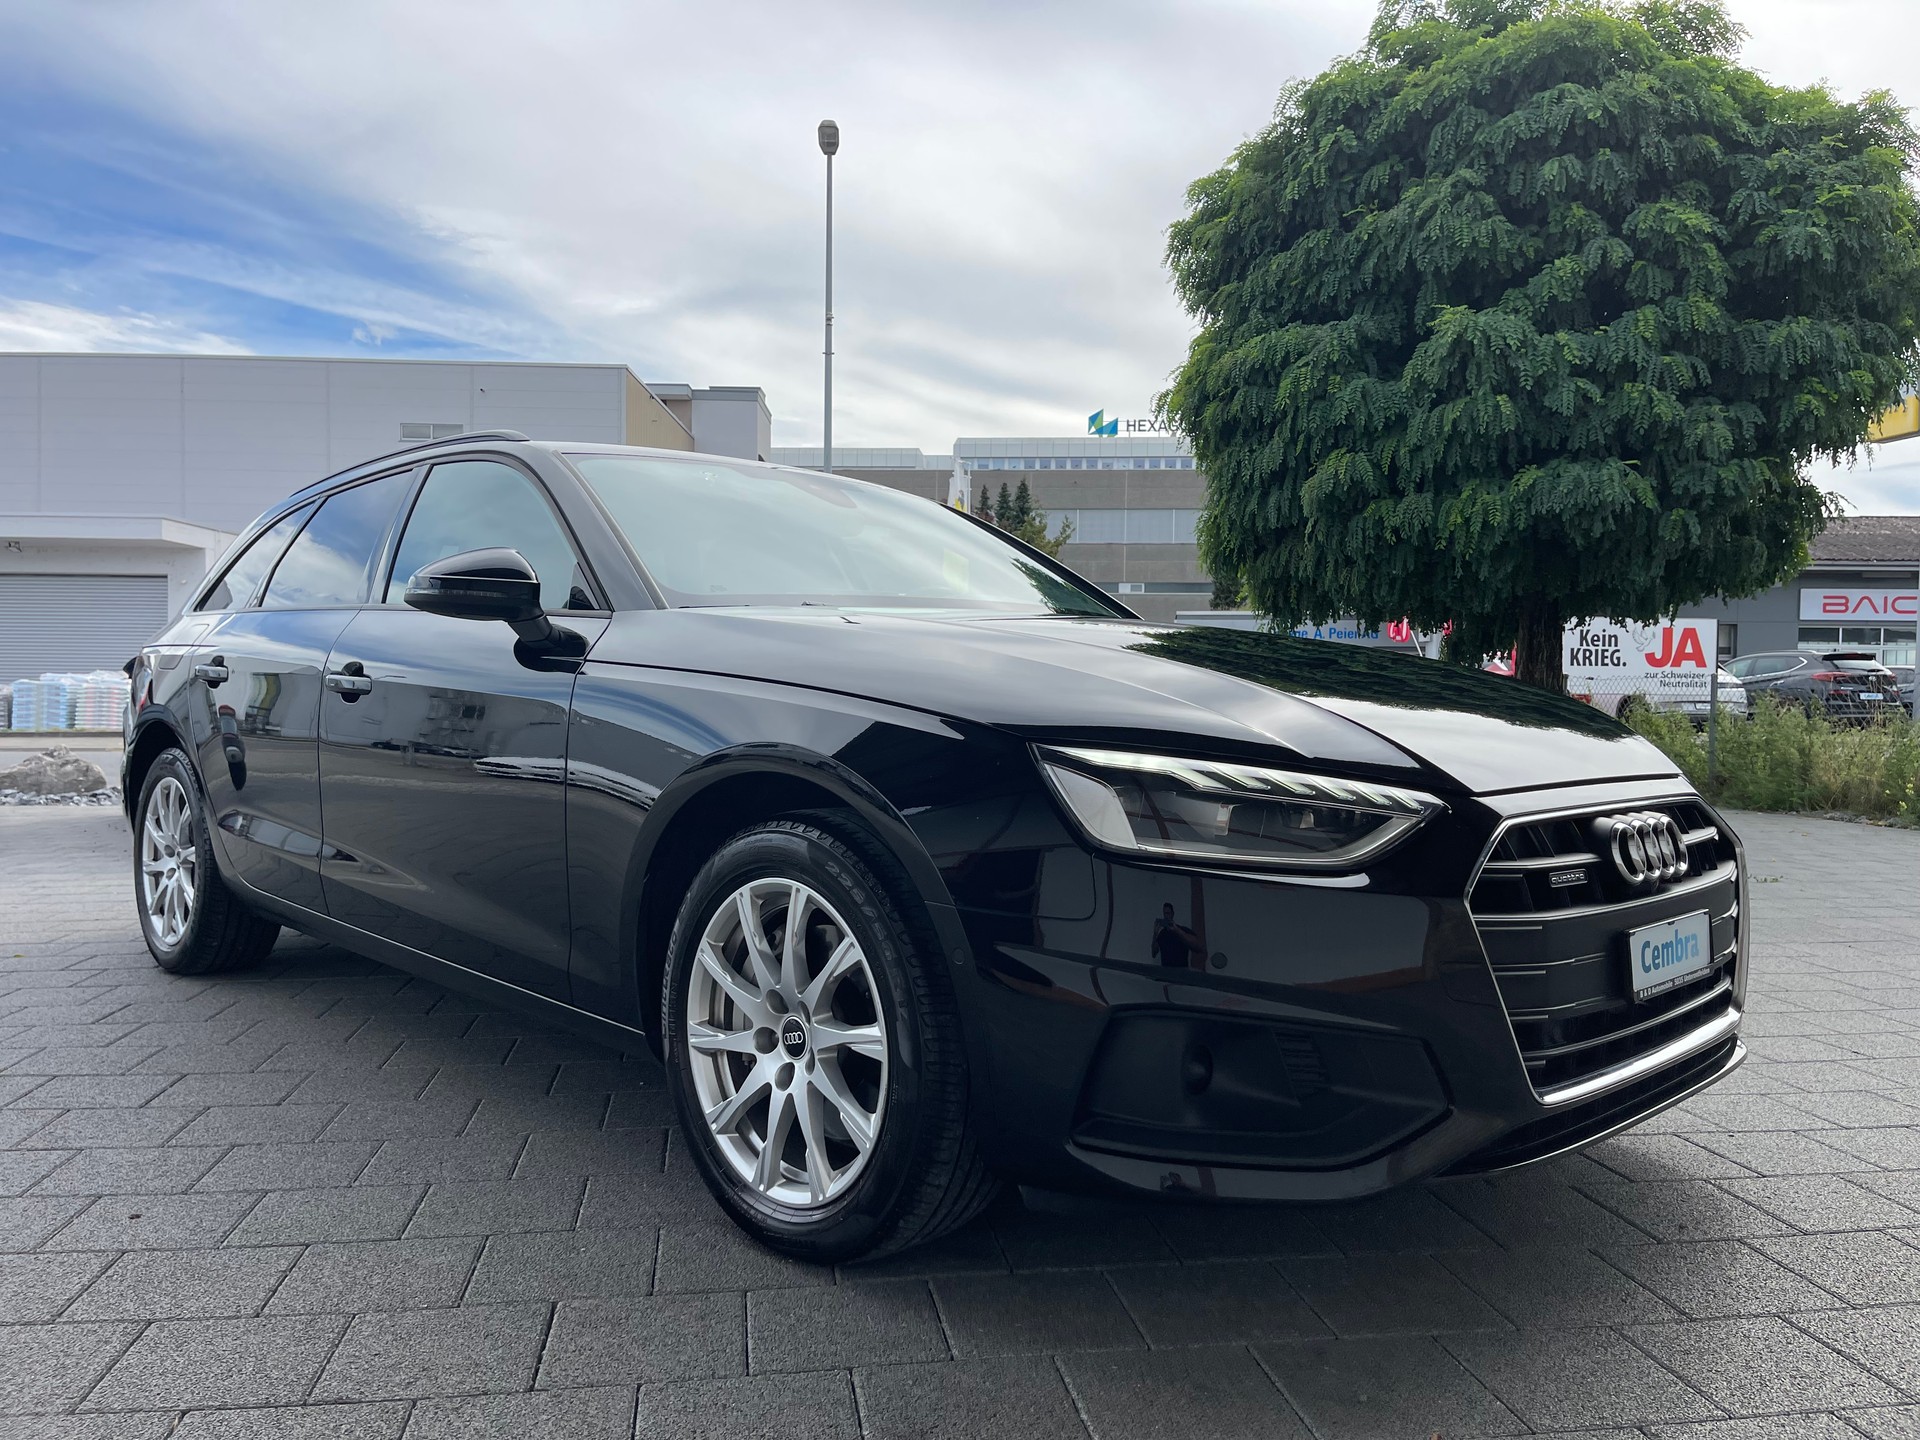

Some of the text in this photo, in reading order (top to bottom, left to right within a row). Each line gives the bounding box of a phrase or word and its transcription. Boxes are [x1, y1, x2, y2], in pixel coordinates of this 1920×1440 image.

[1126, 419, 1180, 432] HEXAG
[1822, 595, 1918, 614] BAIC
[1579, 629, 1618, 648] Kein
[1644, 627, 1707, 668] JA
[1570, 648, 1627, 667] KRIEG.
[1644, 670, 1705, 679] zur Schweizer
[1660, 680, 1707, 688] Neutralität
[1551, 873, 1585, 883] quattro
[1641, 929, 1699, 973] Cembra
